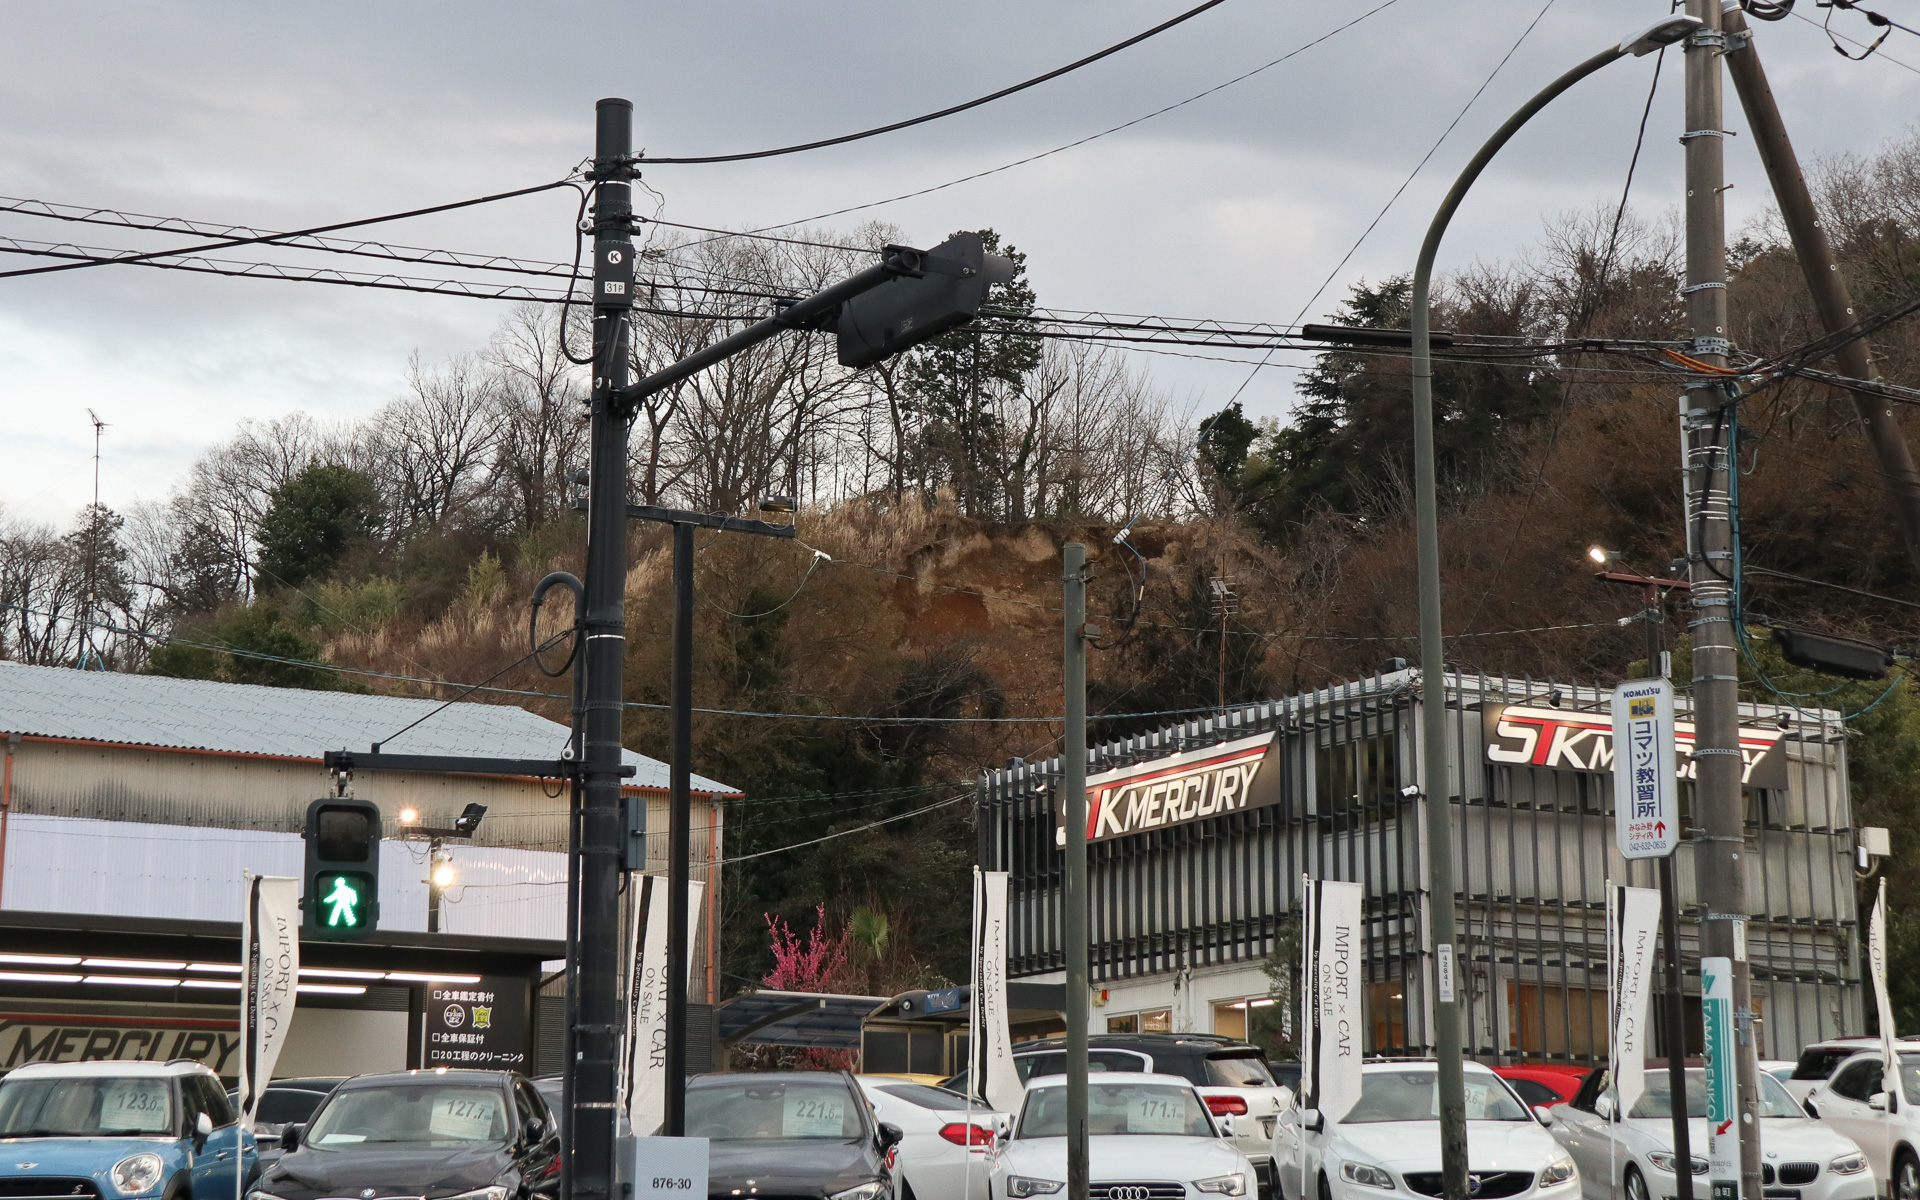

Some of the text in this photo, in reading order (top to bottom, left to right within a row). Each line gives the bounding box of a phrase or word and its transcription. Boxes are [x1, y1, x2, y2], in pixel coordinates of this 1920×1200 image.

[611, 253, 619, 261] K
[1623, 687, 1661, 699] KOMATSU
[1634, 720, 1656, 818] コマツ教習所
[1629, 840, 1667, 852] 042-632-0635
[264, 957, 274, 979] ON
[274, 916, 291, 997] IMPORT
[1335, 925, 1350, 999] IMPORT
[1629, 929, 1647, 998] IMPORT
[639, 967, 656, 1024] ON SALE
[985, 960, 995, 1017] ON SALE
[1322, 964, 1333, 1017] ON SALE
[1338, 1019, 1351, 1058] CAR
[1624, 1017, 1634, 1053] CAR
[652, 1178, 692, 1190] 876-30
